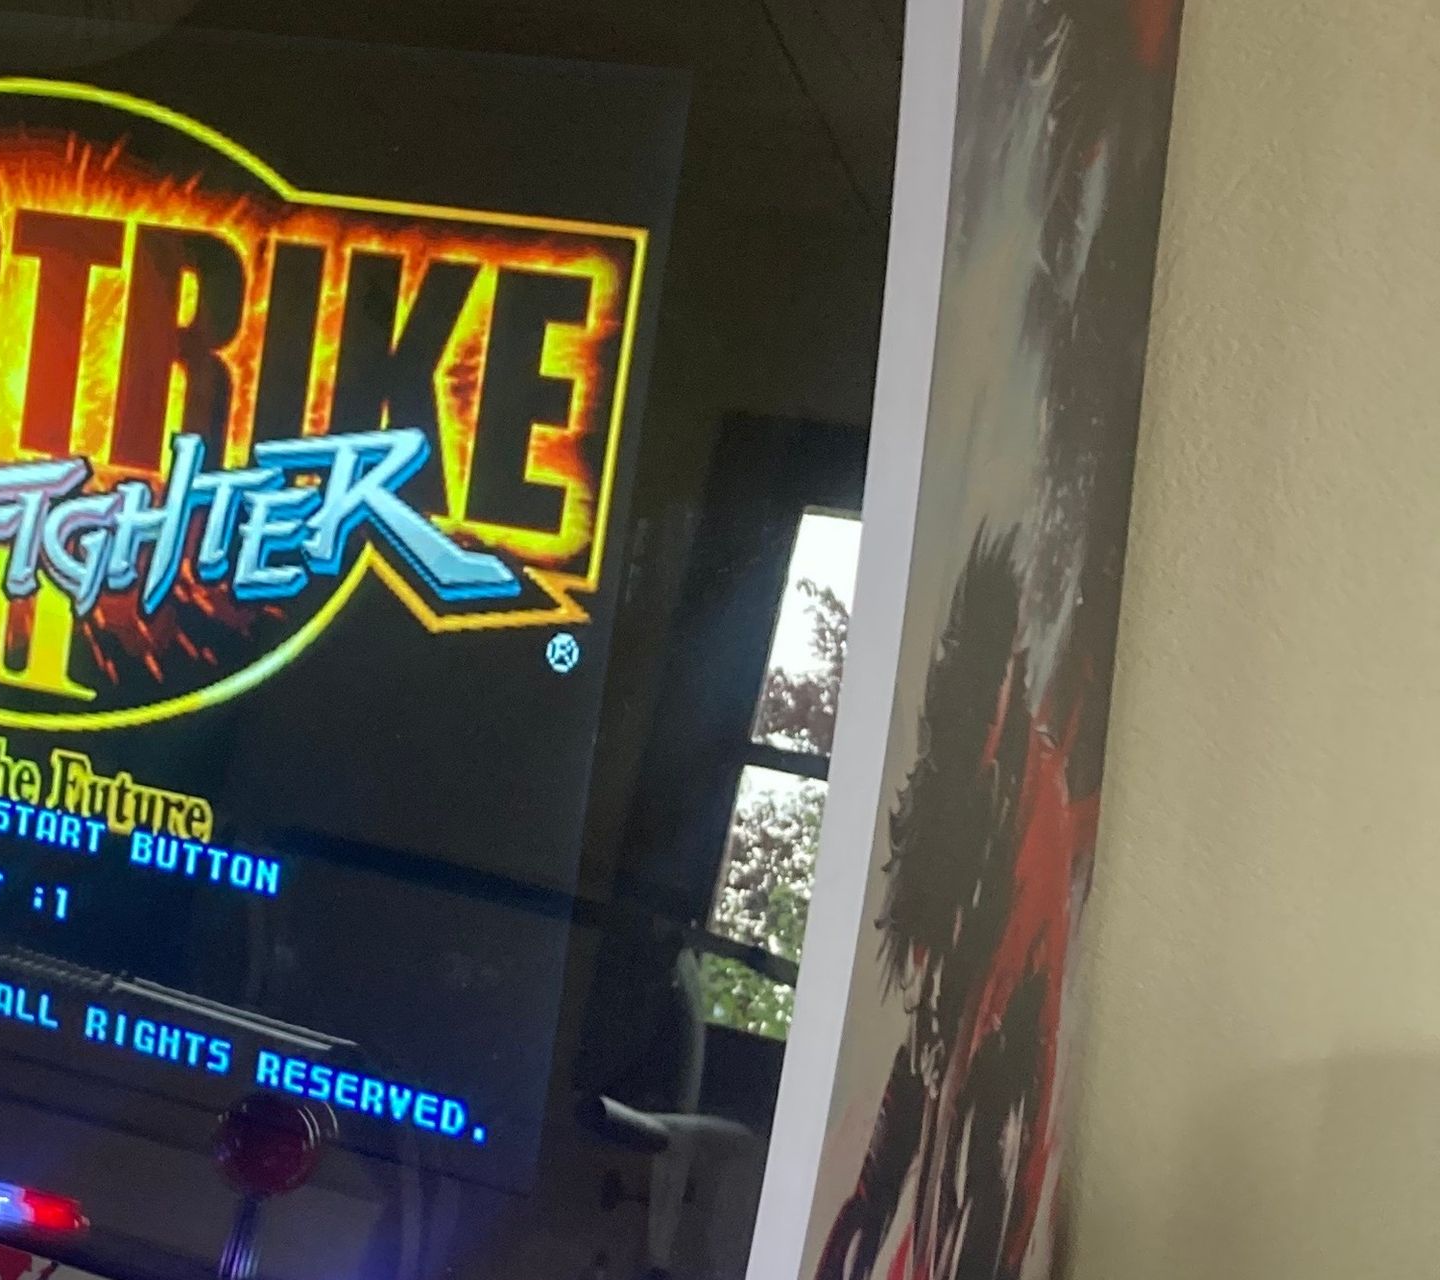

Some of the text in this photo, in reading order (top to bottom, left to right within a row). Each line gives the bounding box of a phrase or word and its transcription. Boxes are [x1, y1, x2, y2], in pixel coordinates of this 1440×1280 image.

[45, 749, 215, 844] Future
[129, 832, 282, 896] BUTTON
[84, 1005, 233, 1074] RIGHTS
[255, 1050, 488, 1143] RESERVED.
